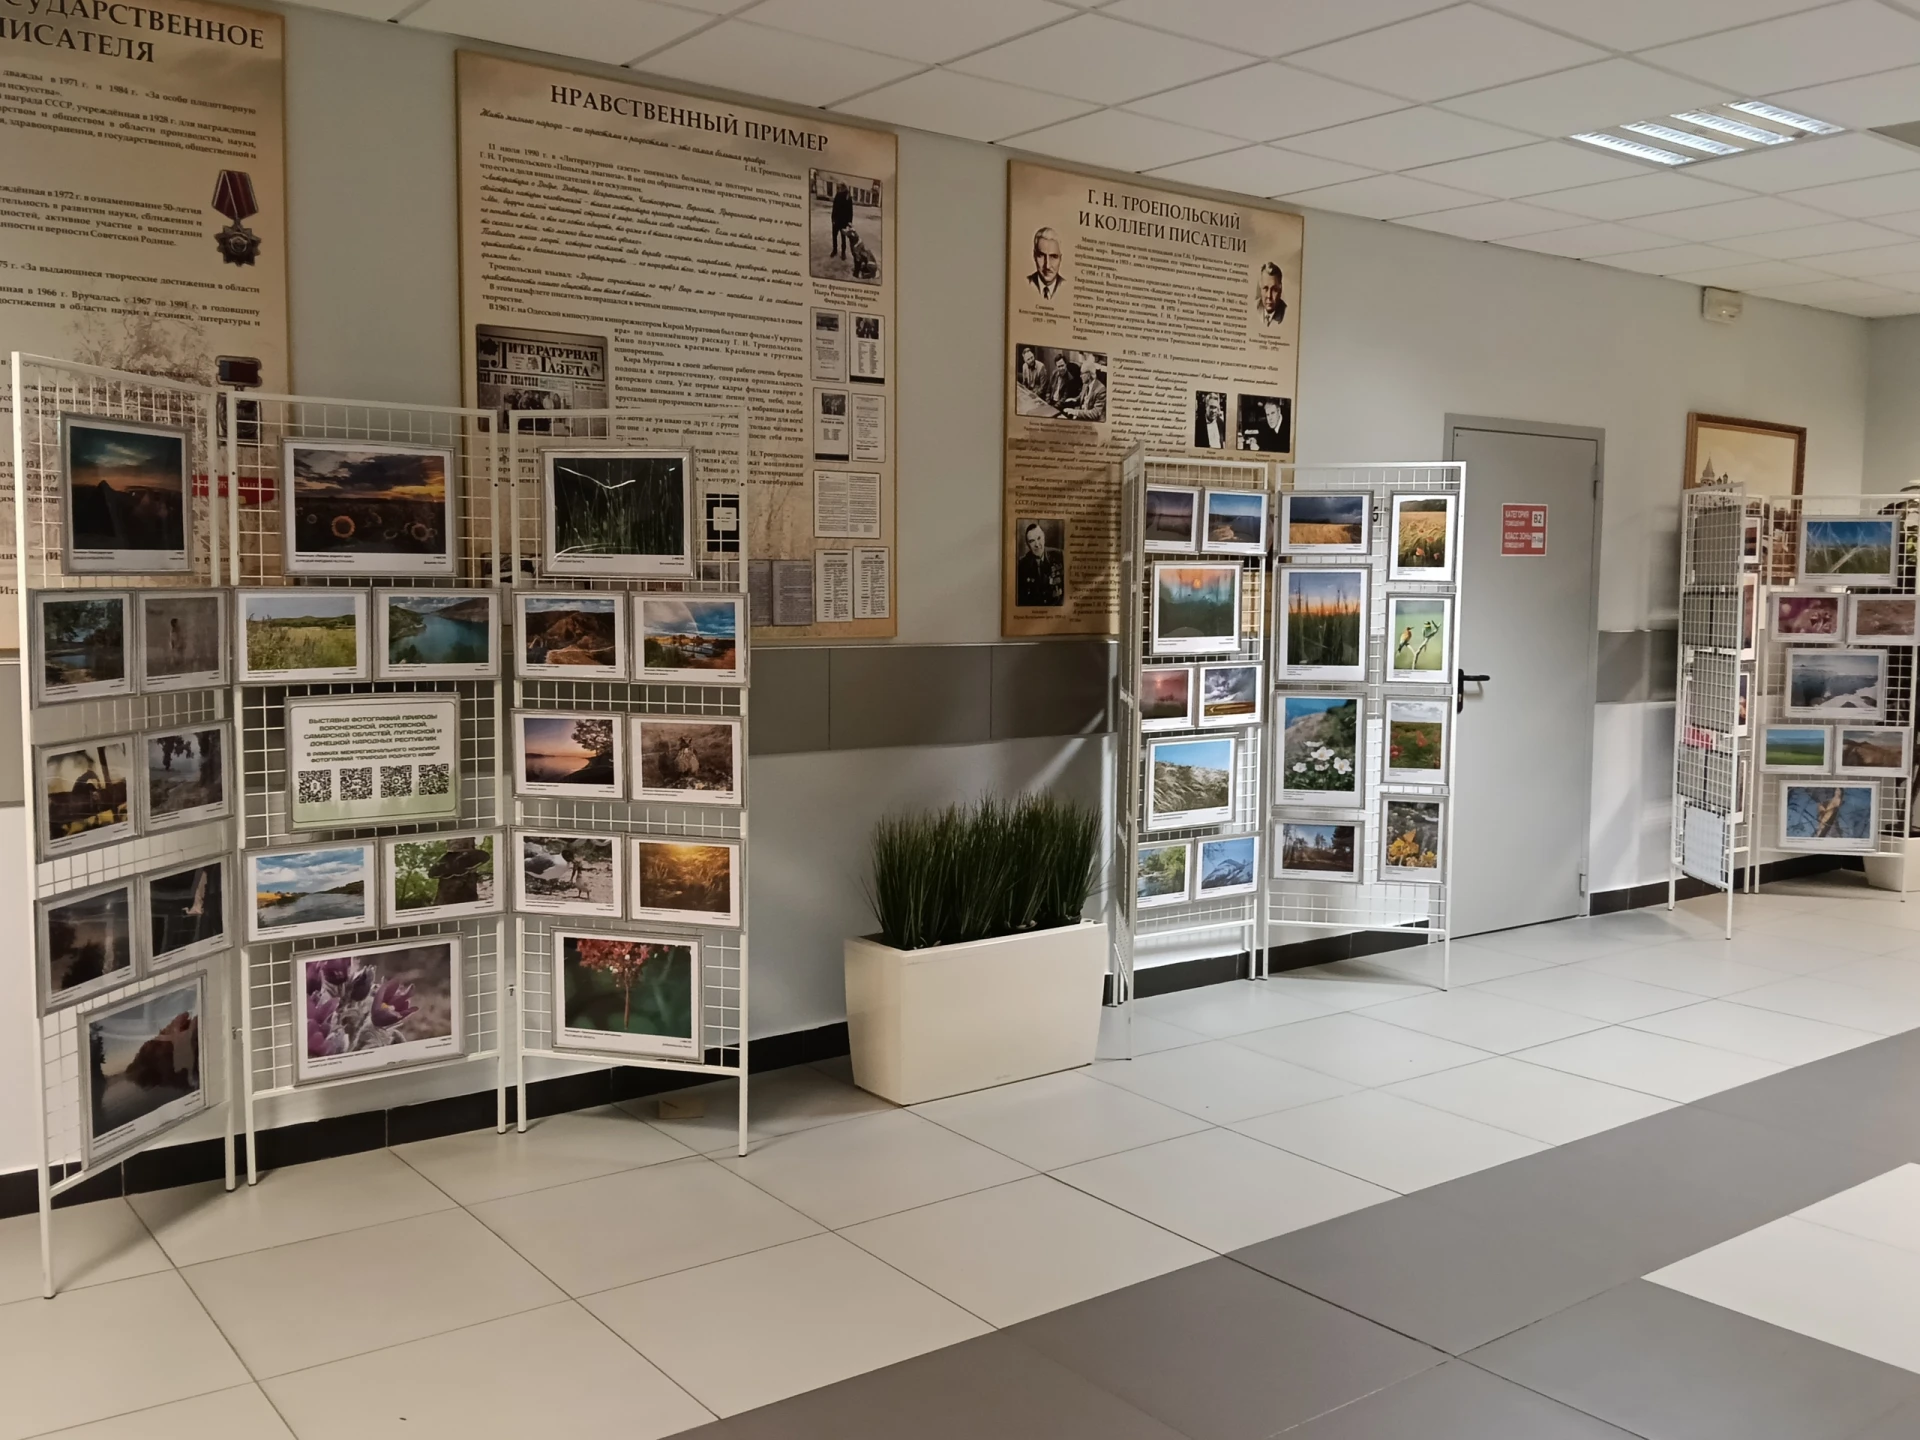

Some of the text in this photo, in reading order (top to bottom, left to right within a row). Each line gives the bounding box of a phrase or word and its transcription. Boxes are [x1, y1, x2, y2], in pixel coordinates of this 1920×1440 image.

[551, 85, 829, 152] НРАВСТВЕННЫЙ ПРИМЕР
[1088, 189, 1240, 230] Г. Н. ТРОЕПОЛЬСКИЙ
[1079, 211, 1247, 253] И КОЛЛЕГИ ПИСАТЕЛИ
[541, 356, 591, 377] ГАЗЕТА
